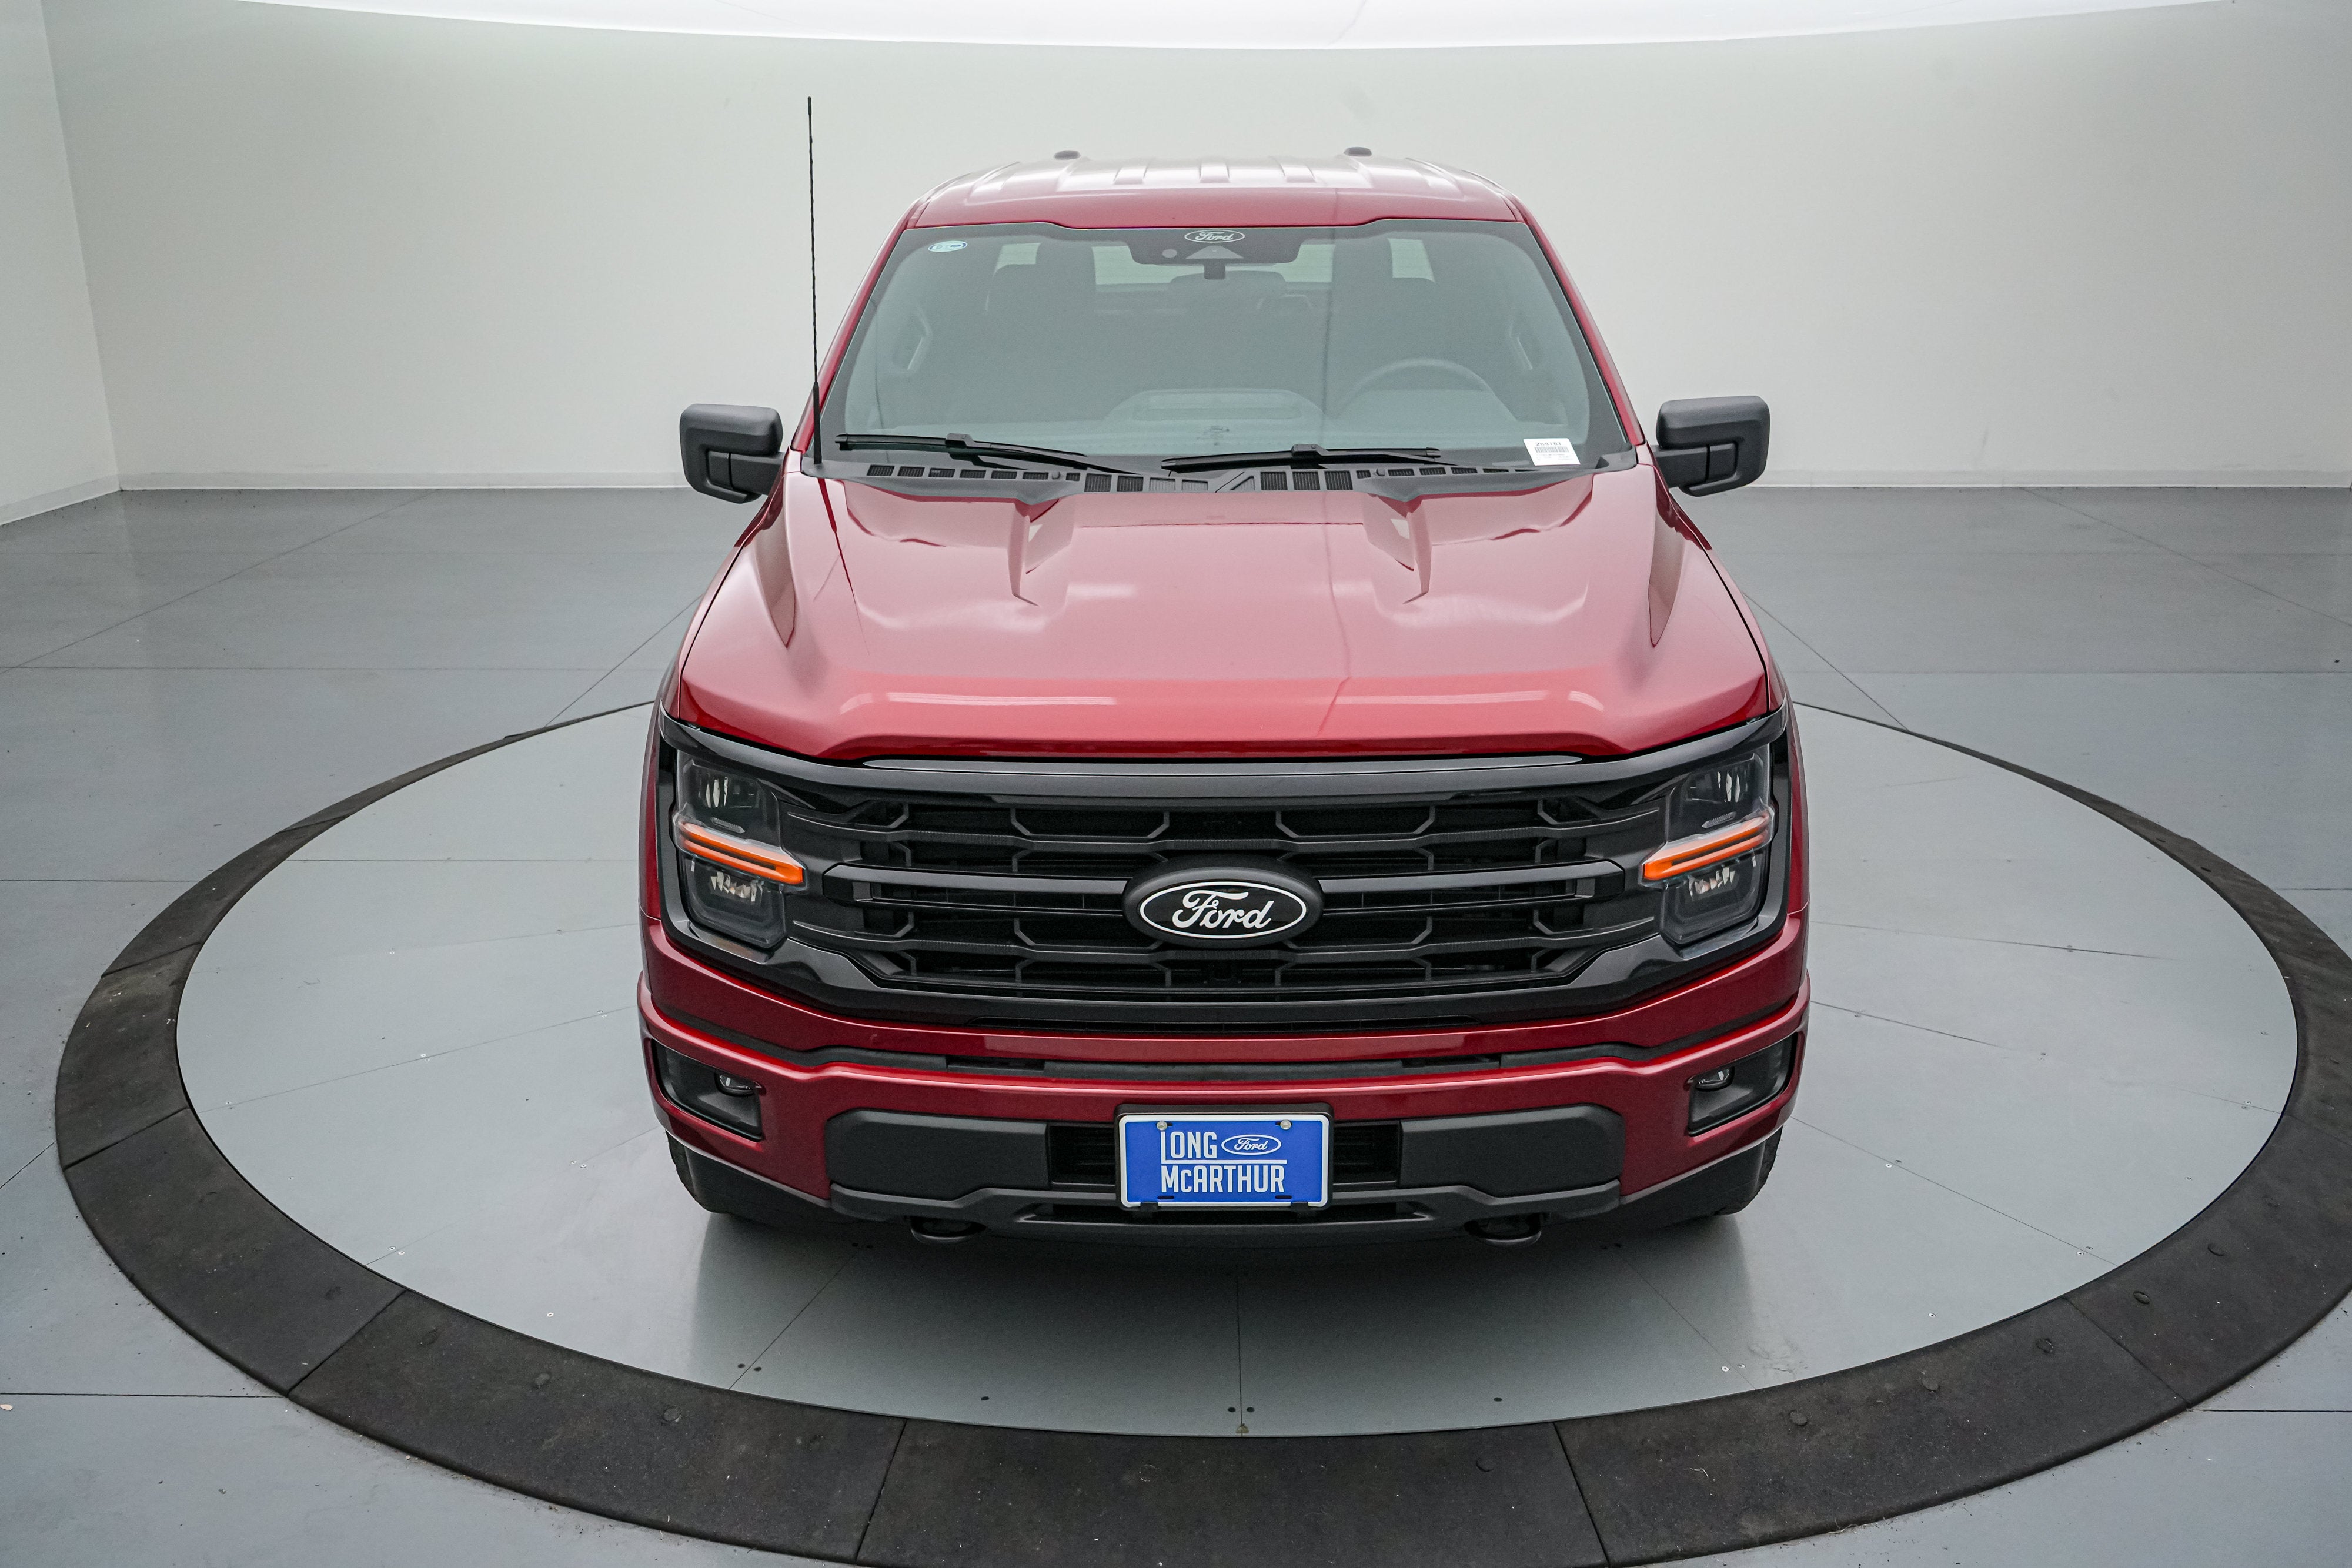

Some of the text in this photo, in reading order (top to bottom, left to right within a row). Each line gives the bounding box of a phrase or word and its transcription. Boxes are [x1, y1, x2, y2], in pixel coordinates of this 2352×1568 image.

[1195, 231, 1234, 240] Ford
[1172, 890, 1275, 929] Ford
[1160, 1131, 1268, 1164] LONG Ford
[1161, 1165, 1284, 1193] McARTHUR
